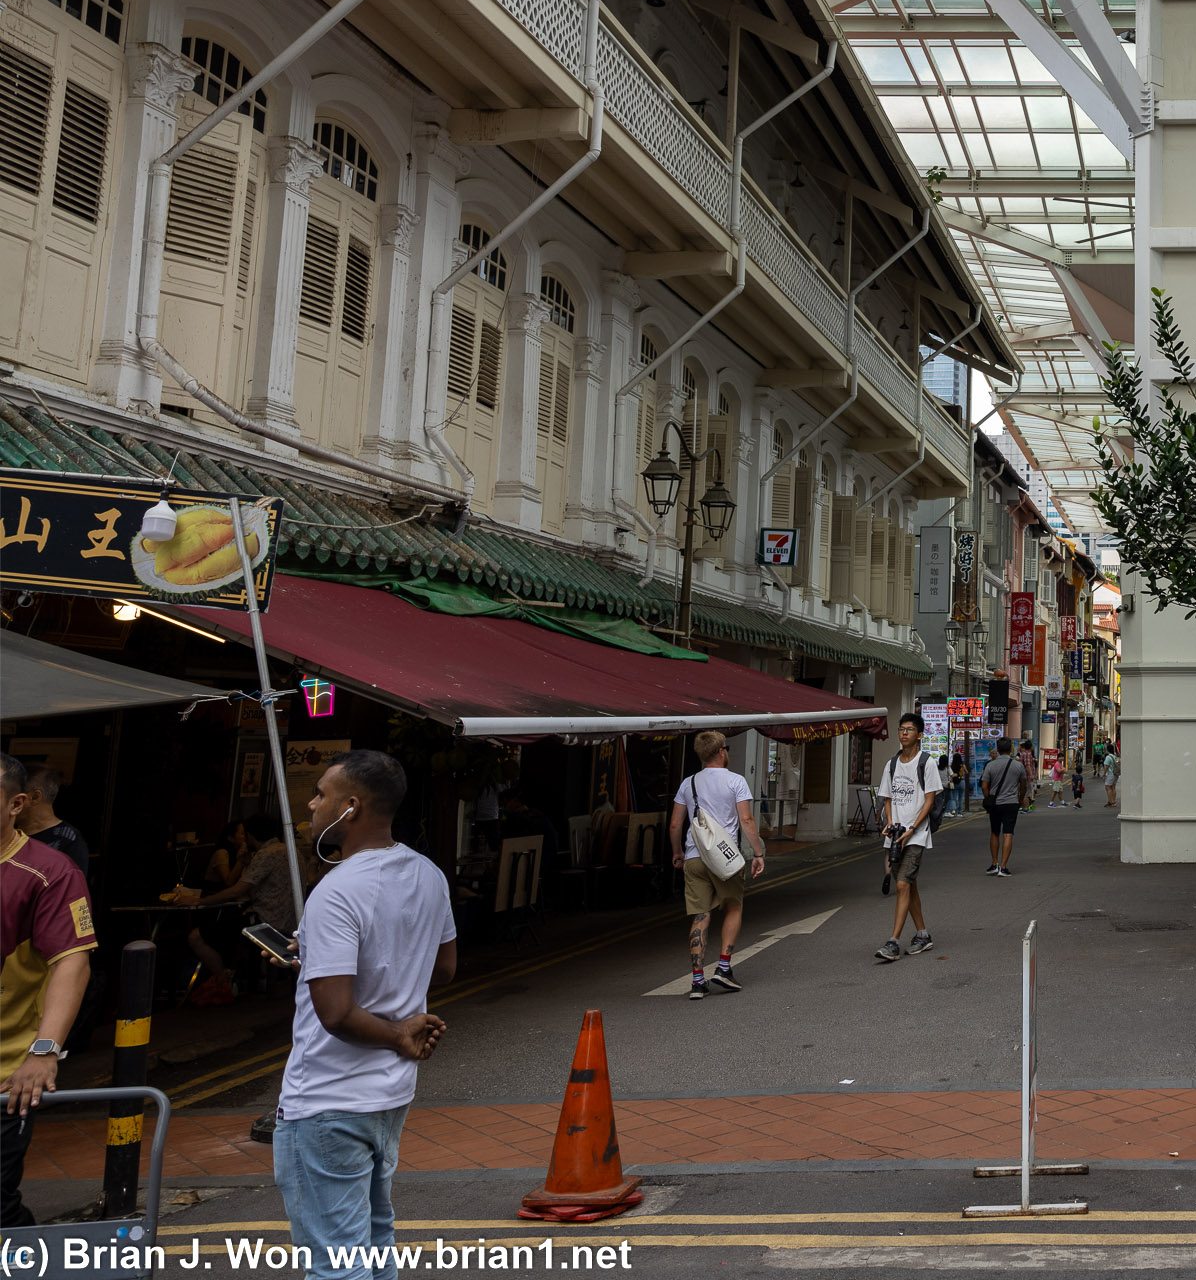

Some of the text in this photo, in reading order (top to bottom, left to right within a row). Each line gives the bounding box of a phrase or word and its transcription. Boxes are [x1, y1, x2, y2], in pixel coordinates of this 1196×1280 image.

[767, 533, 789, 563] 7
[958, 533, 975, 584] 烤好了
[948, 700, 983, 708] 延边烤串
[948, 708, 969, 716] 东北菜
[970, 708, 983, 716] 川菜
